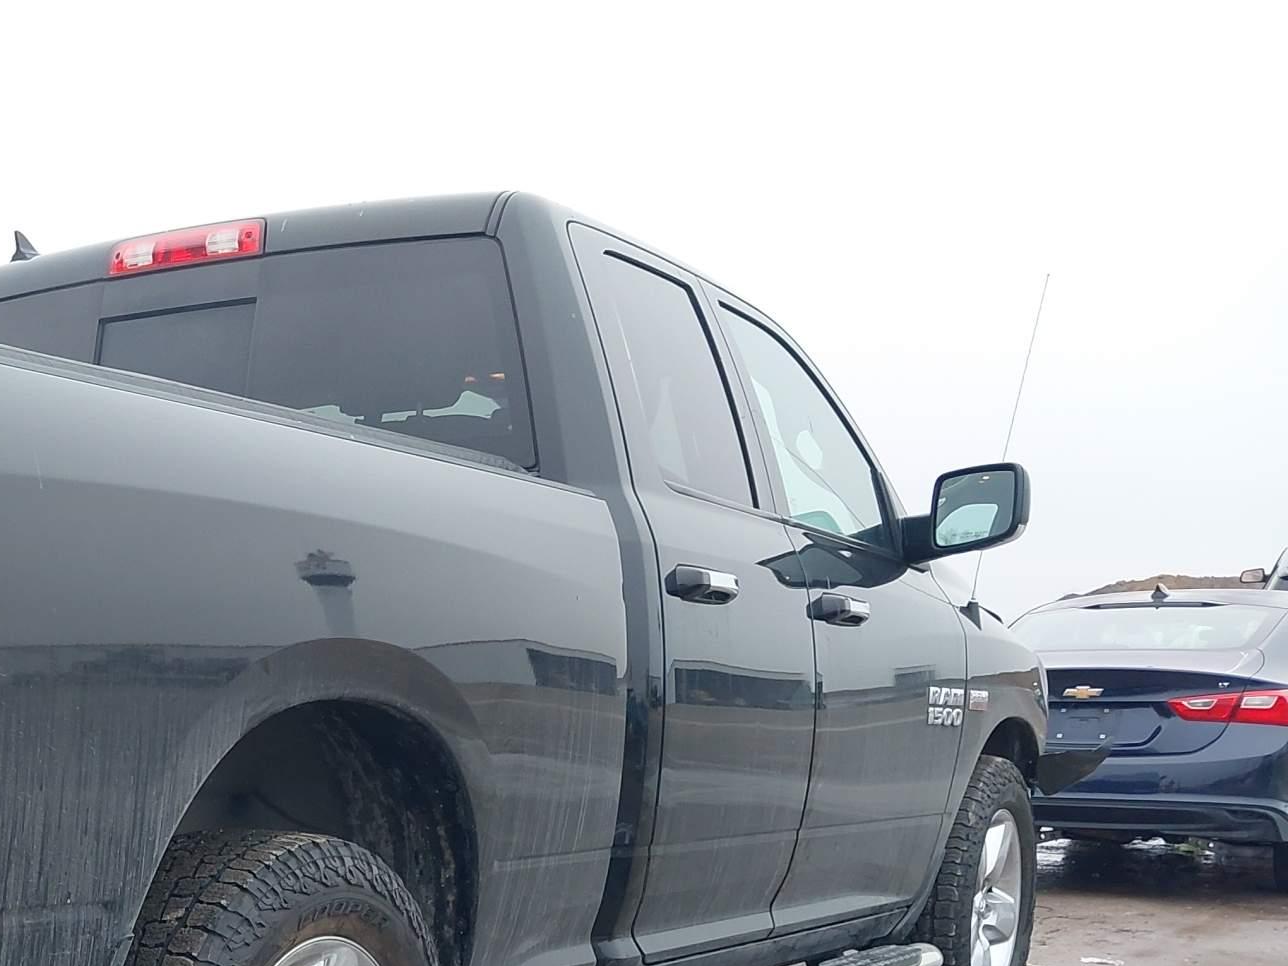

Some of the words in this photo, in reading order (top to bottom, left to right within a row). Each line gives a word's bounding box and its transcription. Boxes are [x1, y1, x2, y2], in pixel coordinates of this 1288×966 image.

[928, 686, 965, 706] RAM
[927, 707, 963, 727] 1500
[297, 900, 390, 932] COOPER
